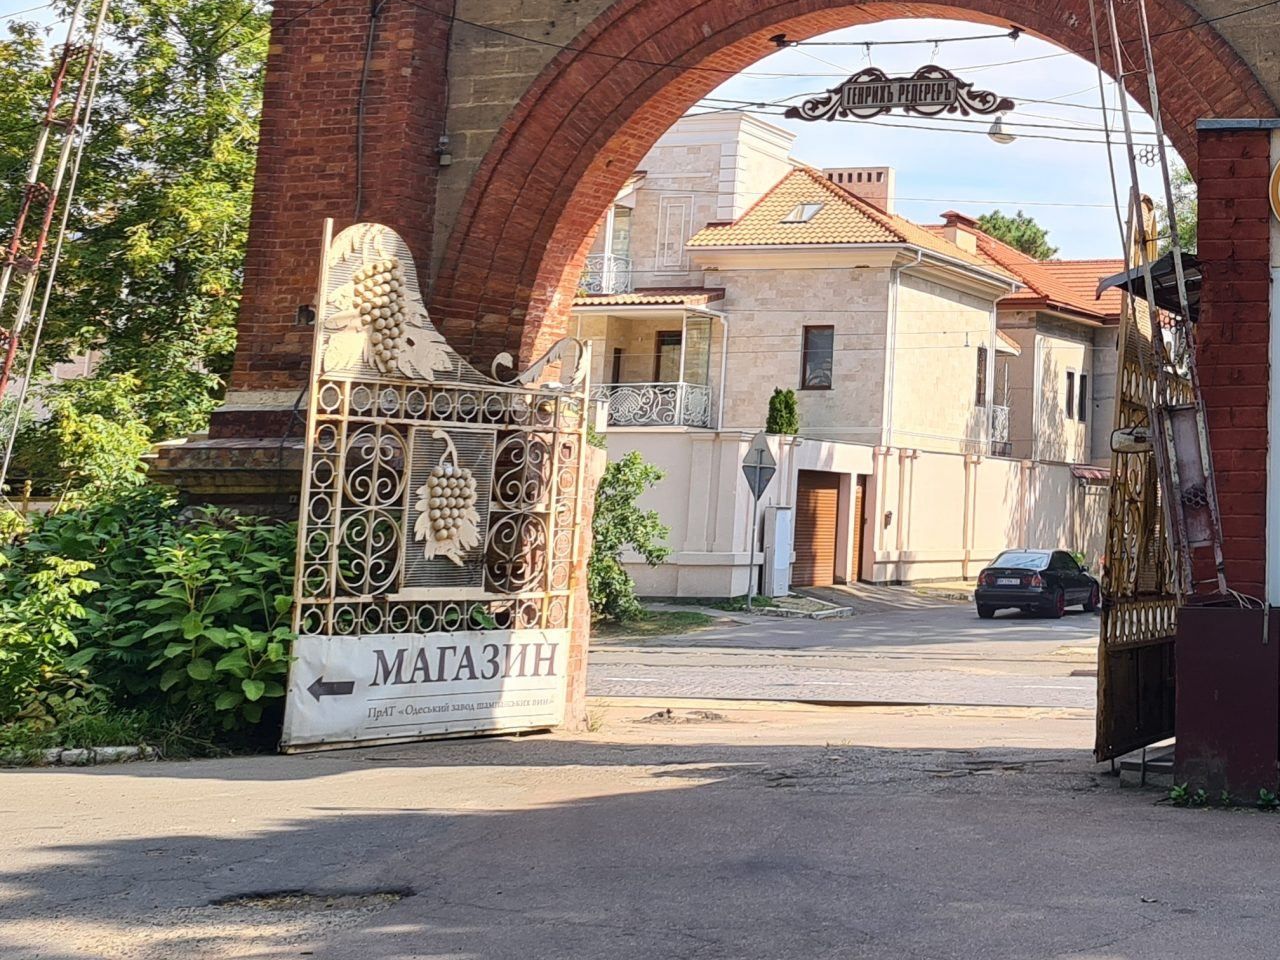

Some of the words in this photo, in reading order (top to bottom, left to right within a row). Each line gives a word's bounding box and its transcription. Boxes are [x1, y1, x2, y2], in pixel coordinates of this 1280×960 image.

[368, 643, 560, 688] МАГАЗИН
[367, 705, 397, 721] ПрАТ
[450, 702, 475, 712] завод
